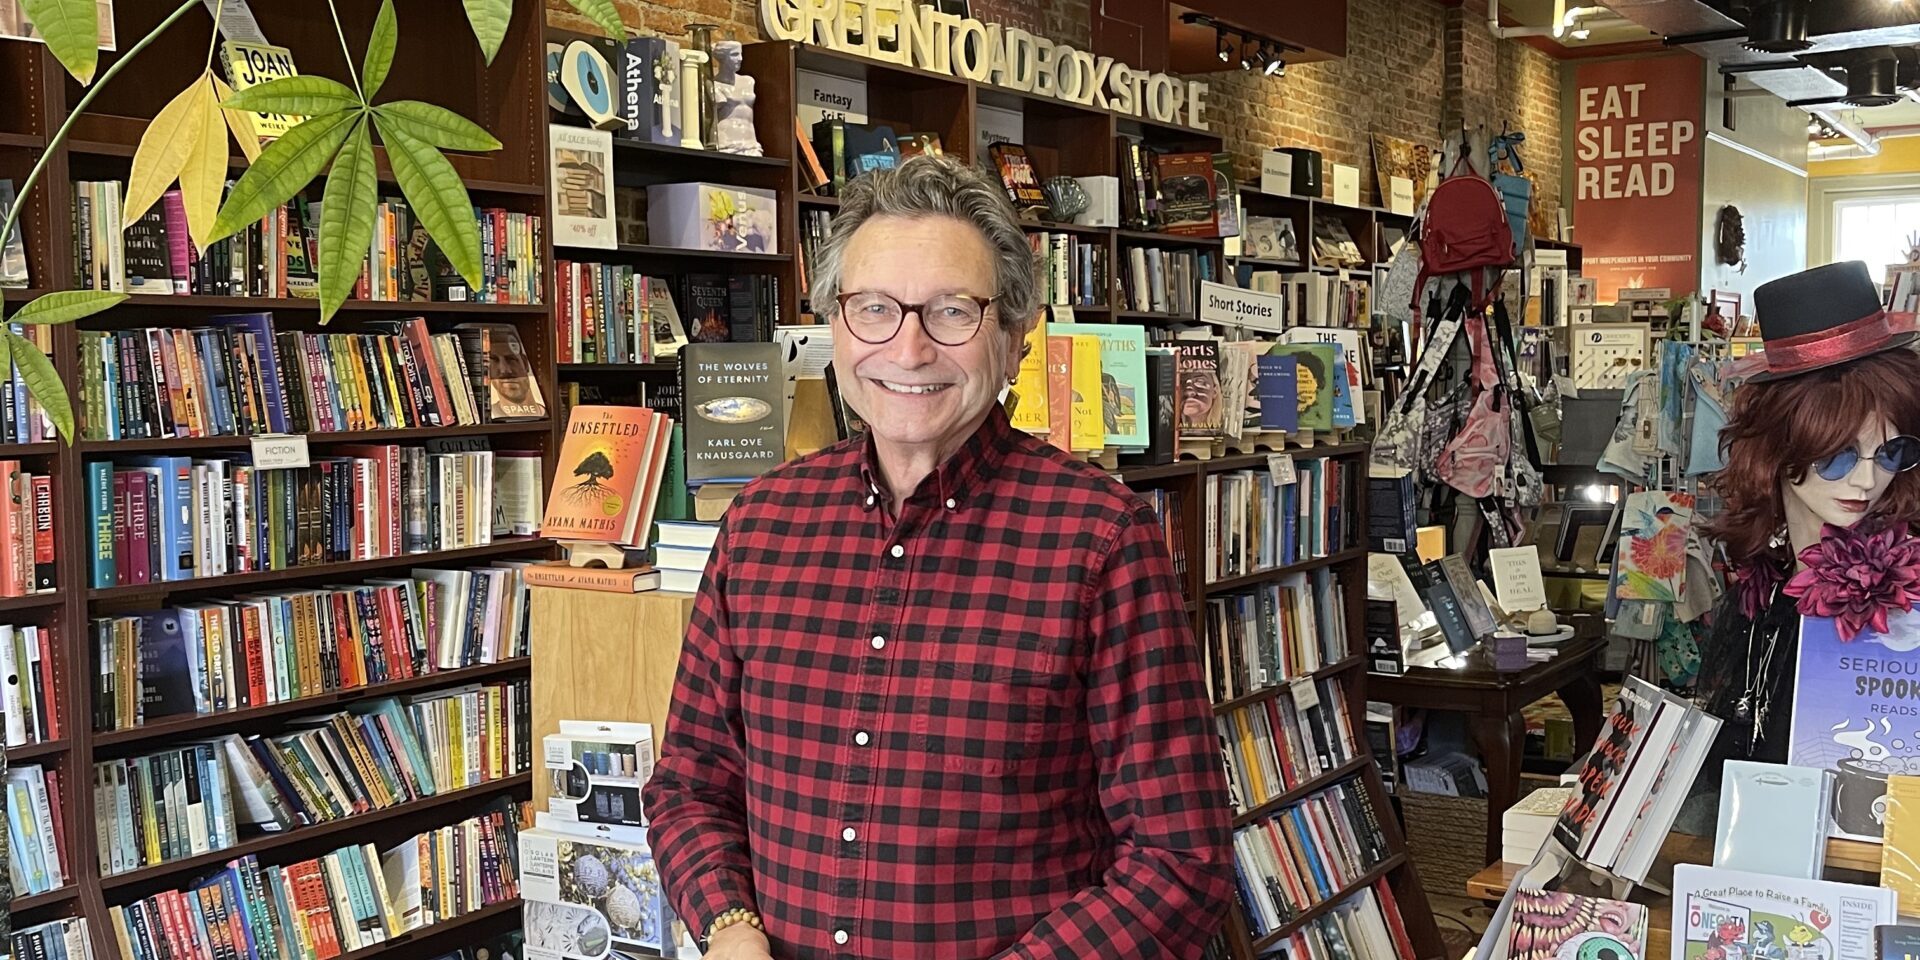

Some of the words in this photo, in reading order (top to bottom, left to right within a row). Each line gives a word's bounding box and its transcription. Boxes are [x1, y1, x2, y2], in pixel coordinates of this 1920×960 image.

[236, 48, 293, 84] JOAN
[626, 52, 643, 131] Athena
[814, 89, 852, 109] Fantasy
[653, 93, 680, 108] Atna
[1580, 84, 1646, 121] EAT
[821, 110, 834, 121] Sci
[982, 130, 1010, 143] Mystery
[1578, 121, 1694, 161] SLEEP
[1578, 162, 1675, 200] READ
[735, 191, 747, 250] Venus
[1600, 256, 1636, 264] INDEPENDENTS
[566, 265, 571, 278] WE
[692, 286, 726, 296] SEVENTH
[696, 297, 723, 309] QUEEN
[1209, 295, 1234, 312] Short
[1236, 300, 1273, 317] Stories
[402, 346, 418, 383] rabbits
[699, 363, 718, 371] THE
[723, 363, 768, 371] WOLVES
[1179, 359, 1217, 369] ones
[717, 375, 770, 383] ETERNITY
[280, 390, 290, 419] DESTINY
[503, 405, 537, 414] SPARE
[647, 398, 681, 408] BOEHN
[602, 411, 613, 419] The
[571, 421, 639, 437] UNSETTLED
[265, 446, 296, 455] FICTION
[708, 439, 735, 447] KARL
[740, 438, 763, 446] OVE
[696, 450, 774, 460] KNAUSGAARD
[36, 485, 51, 531] CHABON
[134, 491, 145, 540] THREE
[113, 495, 125, 541] THREE
[546, 516, 575, 528] AYANA
[579, 517, 616, 531] MATHIS
[24, 511, 32, 546] WALKED
[98, 514, 112, 560] THREE
[26, 548, 34, 562] THE
[27, 563, 35, 579] SKY
[534, 574, 565, 583] UNSETTLED
[577, 576, 595, 585] AYANA
[597, 576, 617, 586] MATHIS
[209, 614, 219, 632] THE
[294, 597, 305, 643] HYPERION
[306, 596, 316, 641] HYPERION
[212, 633, 220, 652] OLD
[213, 654, 223, 680] DRIFT
[249, 658, 257, 688] SETTON
[1871, 703, 1918, 716] READS
[354, 755, 364, 769] MANY
[362, 770, 372, 786] STARS
[365, 752, 375, 766] MANY
[372, 768, 381, 784] STARS
[1579, 764, 1614, 797] OPEN
[38, 788, 46, 801] HOLD
[1357, 776, 1369, 801] WHITE
[1367, 803, 1379, 830] MAGIC
[1353, 779, 1364, 803] WHITE
[1362, 804, 1375, 832] MAGIC
[480, 841, 488, 858] WRIGHT
[254, 872, 262, 884] THE
[257, 886, 265, 902] TWO
[1693, 890, 1701, 898] A
[1703, 889, 1727, 898] Great
[1728, 886, 1753, 897] Place
[1755, 889, 1764, 897] to
[1766, 889, 1791, 901] Raise
[1801, 896, 1830, 915] Family
[261, 904, 270, 922] LIVES
[1842, 900, 1873, 911] INSIDE
[266, 924, 272, 934] OF
[269, 936, 277, 952] SARA
